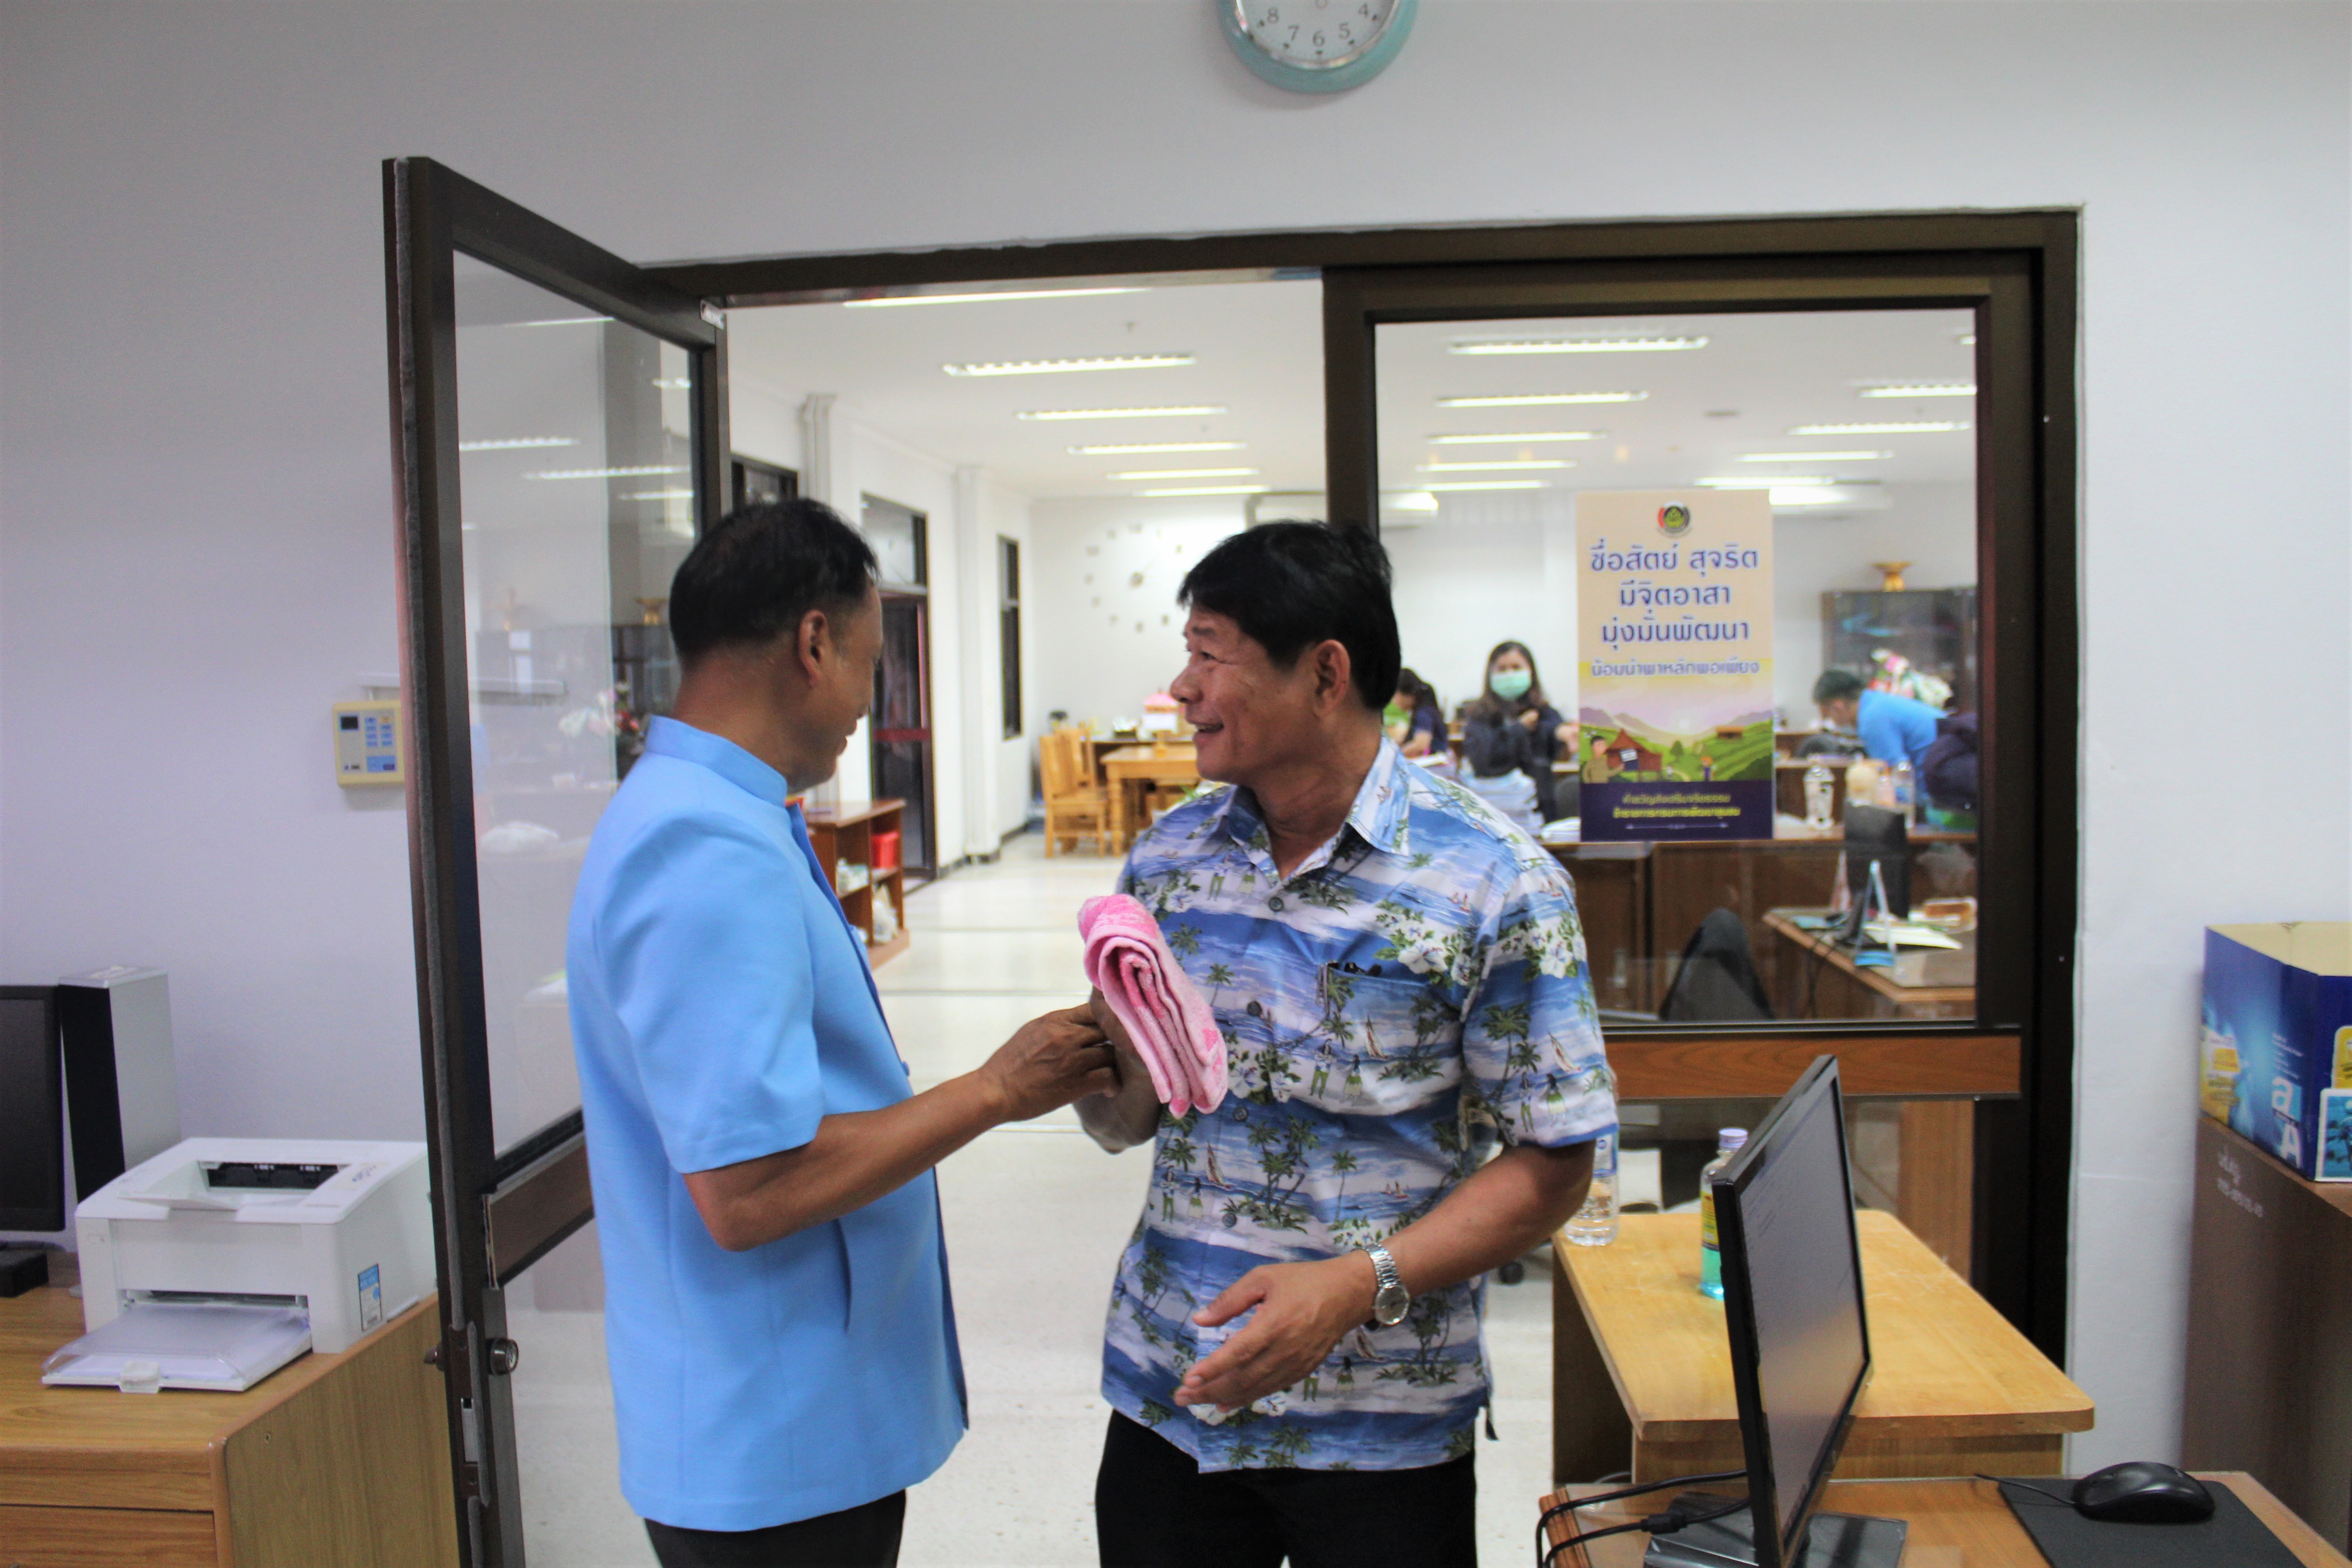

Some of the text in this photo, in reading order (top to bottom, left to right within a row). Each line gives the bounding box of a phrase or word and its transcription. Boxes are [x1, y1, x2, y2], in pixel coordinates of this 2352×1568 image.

[1267, 7, 1279, 23] 8
[1357, 3, 1368, 18] 4
[1288, 25, 1299, 41] 7
[1313, 30, 1325, 46] 6
[1339, 23, 1351, 39] 5
[1690, 544, 1759, 577] สุจริต
[1620, 579, 1730, 606] มีจิตอาสา
[1602, 609, 1749, 651] มุ่งมั่นพัฒนา
